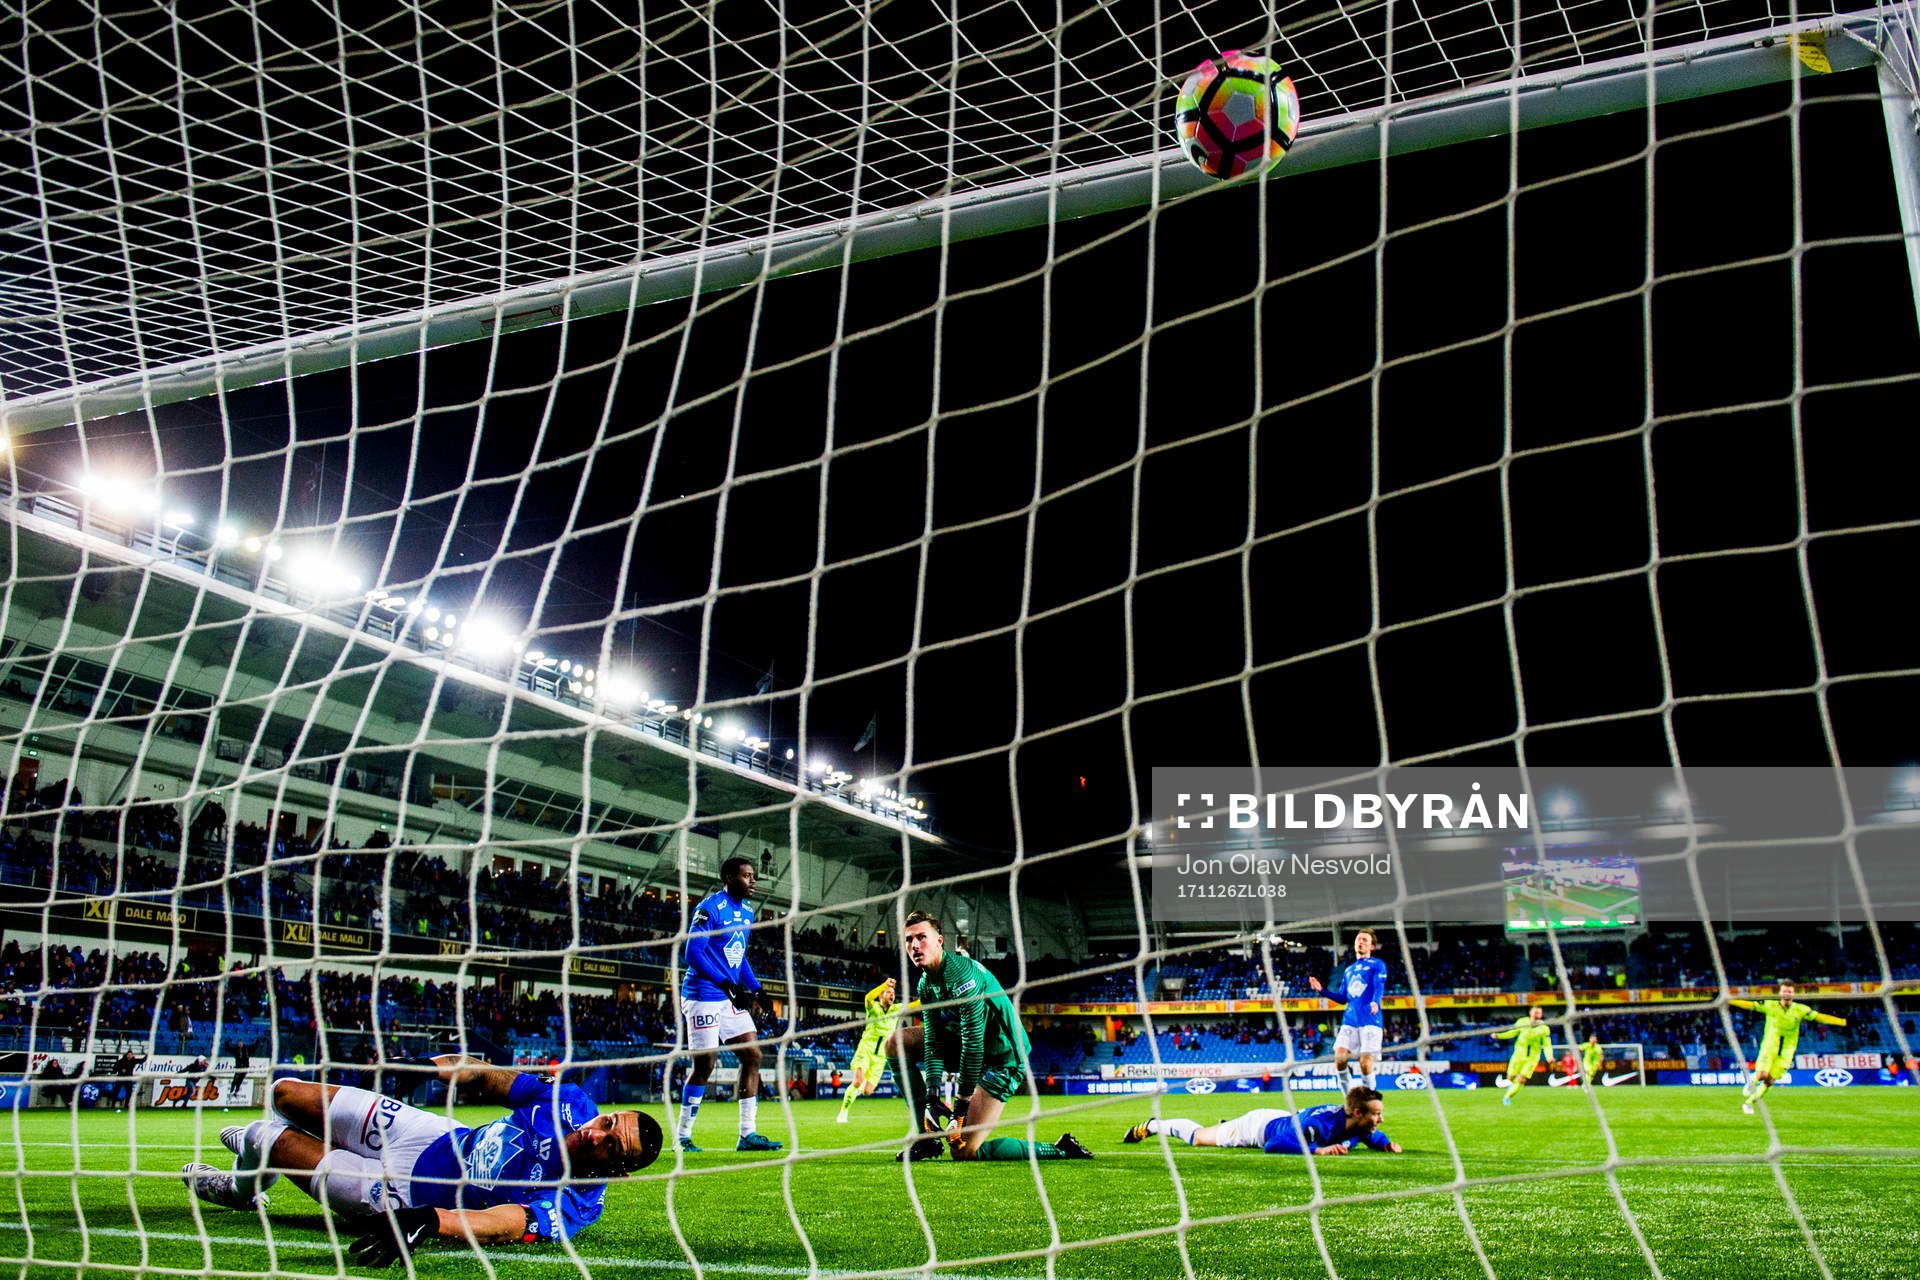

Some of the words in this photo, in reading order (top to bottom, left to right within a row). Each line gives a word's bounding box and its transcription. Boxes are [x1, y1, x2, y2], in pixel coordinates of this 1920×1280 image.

[125, 907, 153, 919] DALE
[156, 911, 187, 923] MAO
[286, 923, 307, 941] XL
[339, 934, 364, 945] MALO
[1803, 1055, 1833, 1068] TIBE
[1844, 1055, 1876, 1068] TIBE
